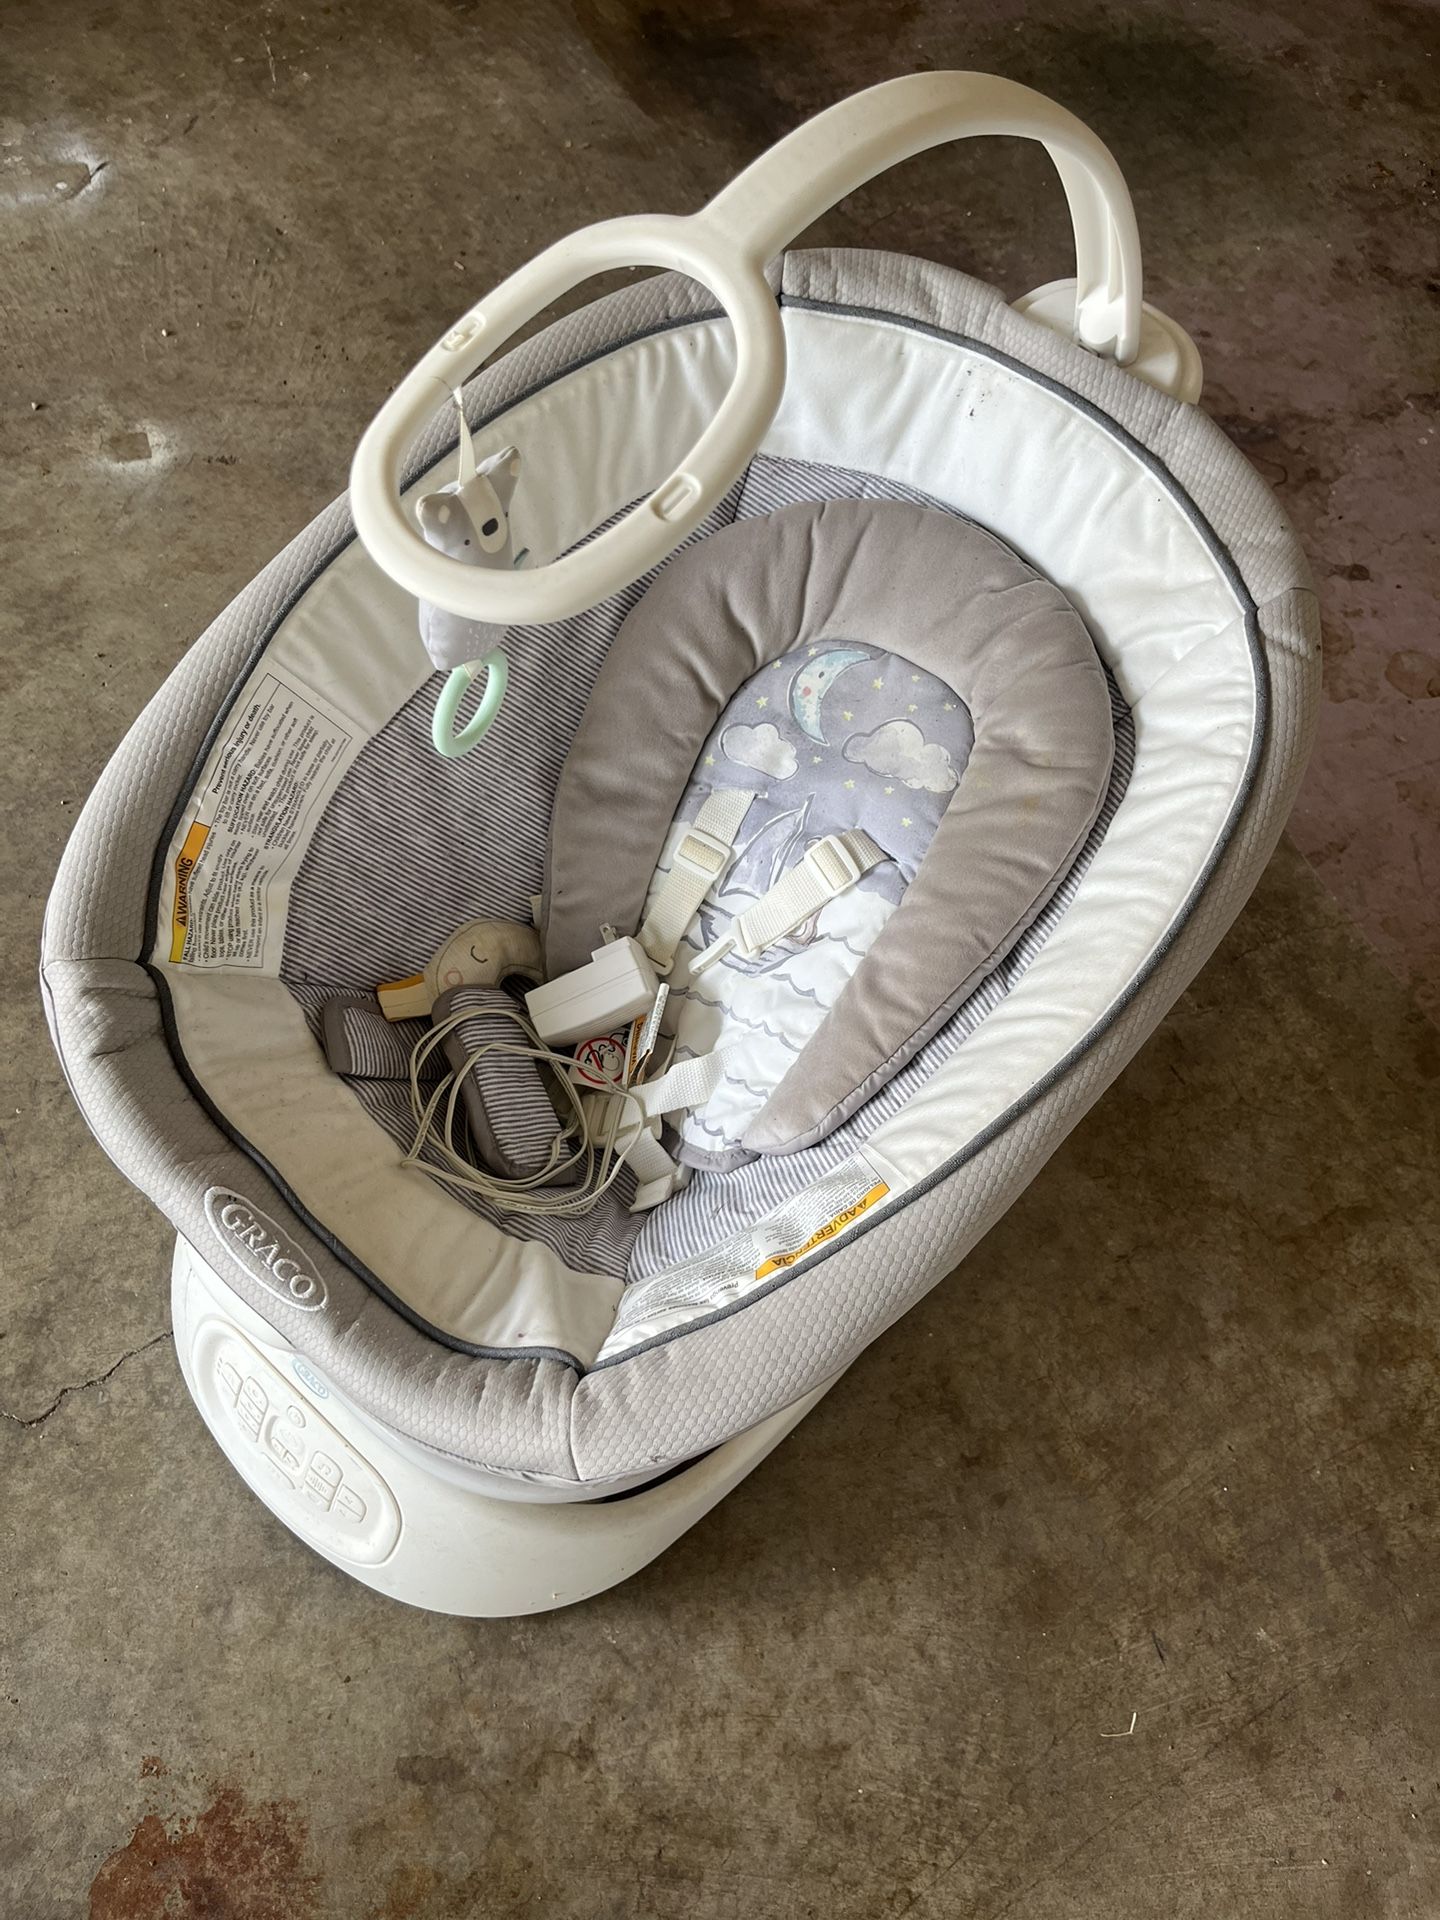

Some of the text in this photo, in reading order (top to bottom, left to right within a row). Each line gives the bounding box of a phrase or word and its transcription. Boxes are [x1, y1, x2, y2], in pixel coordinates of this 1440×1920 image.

[211, 769, 226, 794] Prevent
[233, 728, 248, 747] injury
[244, 721, 250, 729] or
[247, 704, 260, 722] death.
[214, 813, 222, 823] The
[227, 792, 244, 832] SUFFOCATION
[240, 769, 256, 792] HAZARD:
[263, 805, 289, 849] STRANGULATION
[177, 857, 193, 914] WARNING
[182, 946, 191, 960] FALL
[221, 1203, 316, 1299] GRACO
[298, 1363, 326, 1396] GRACO
